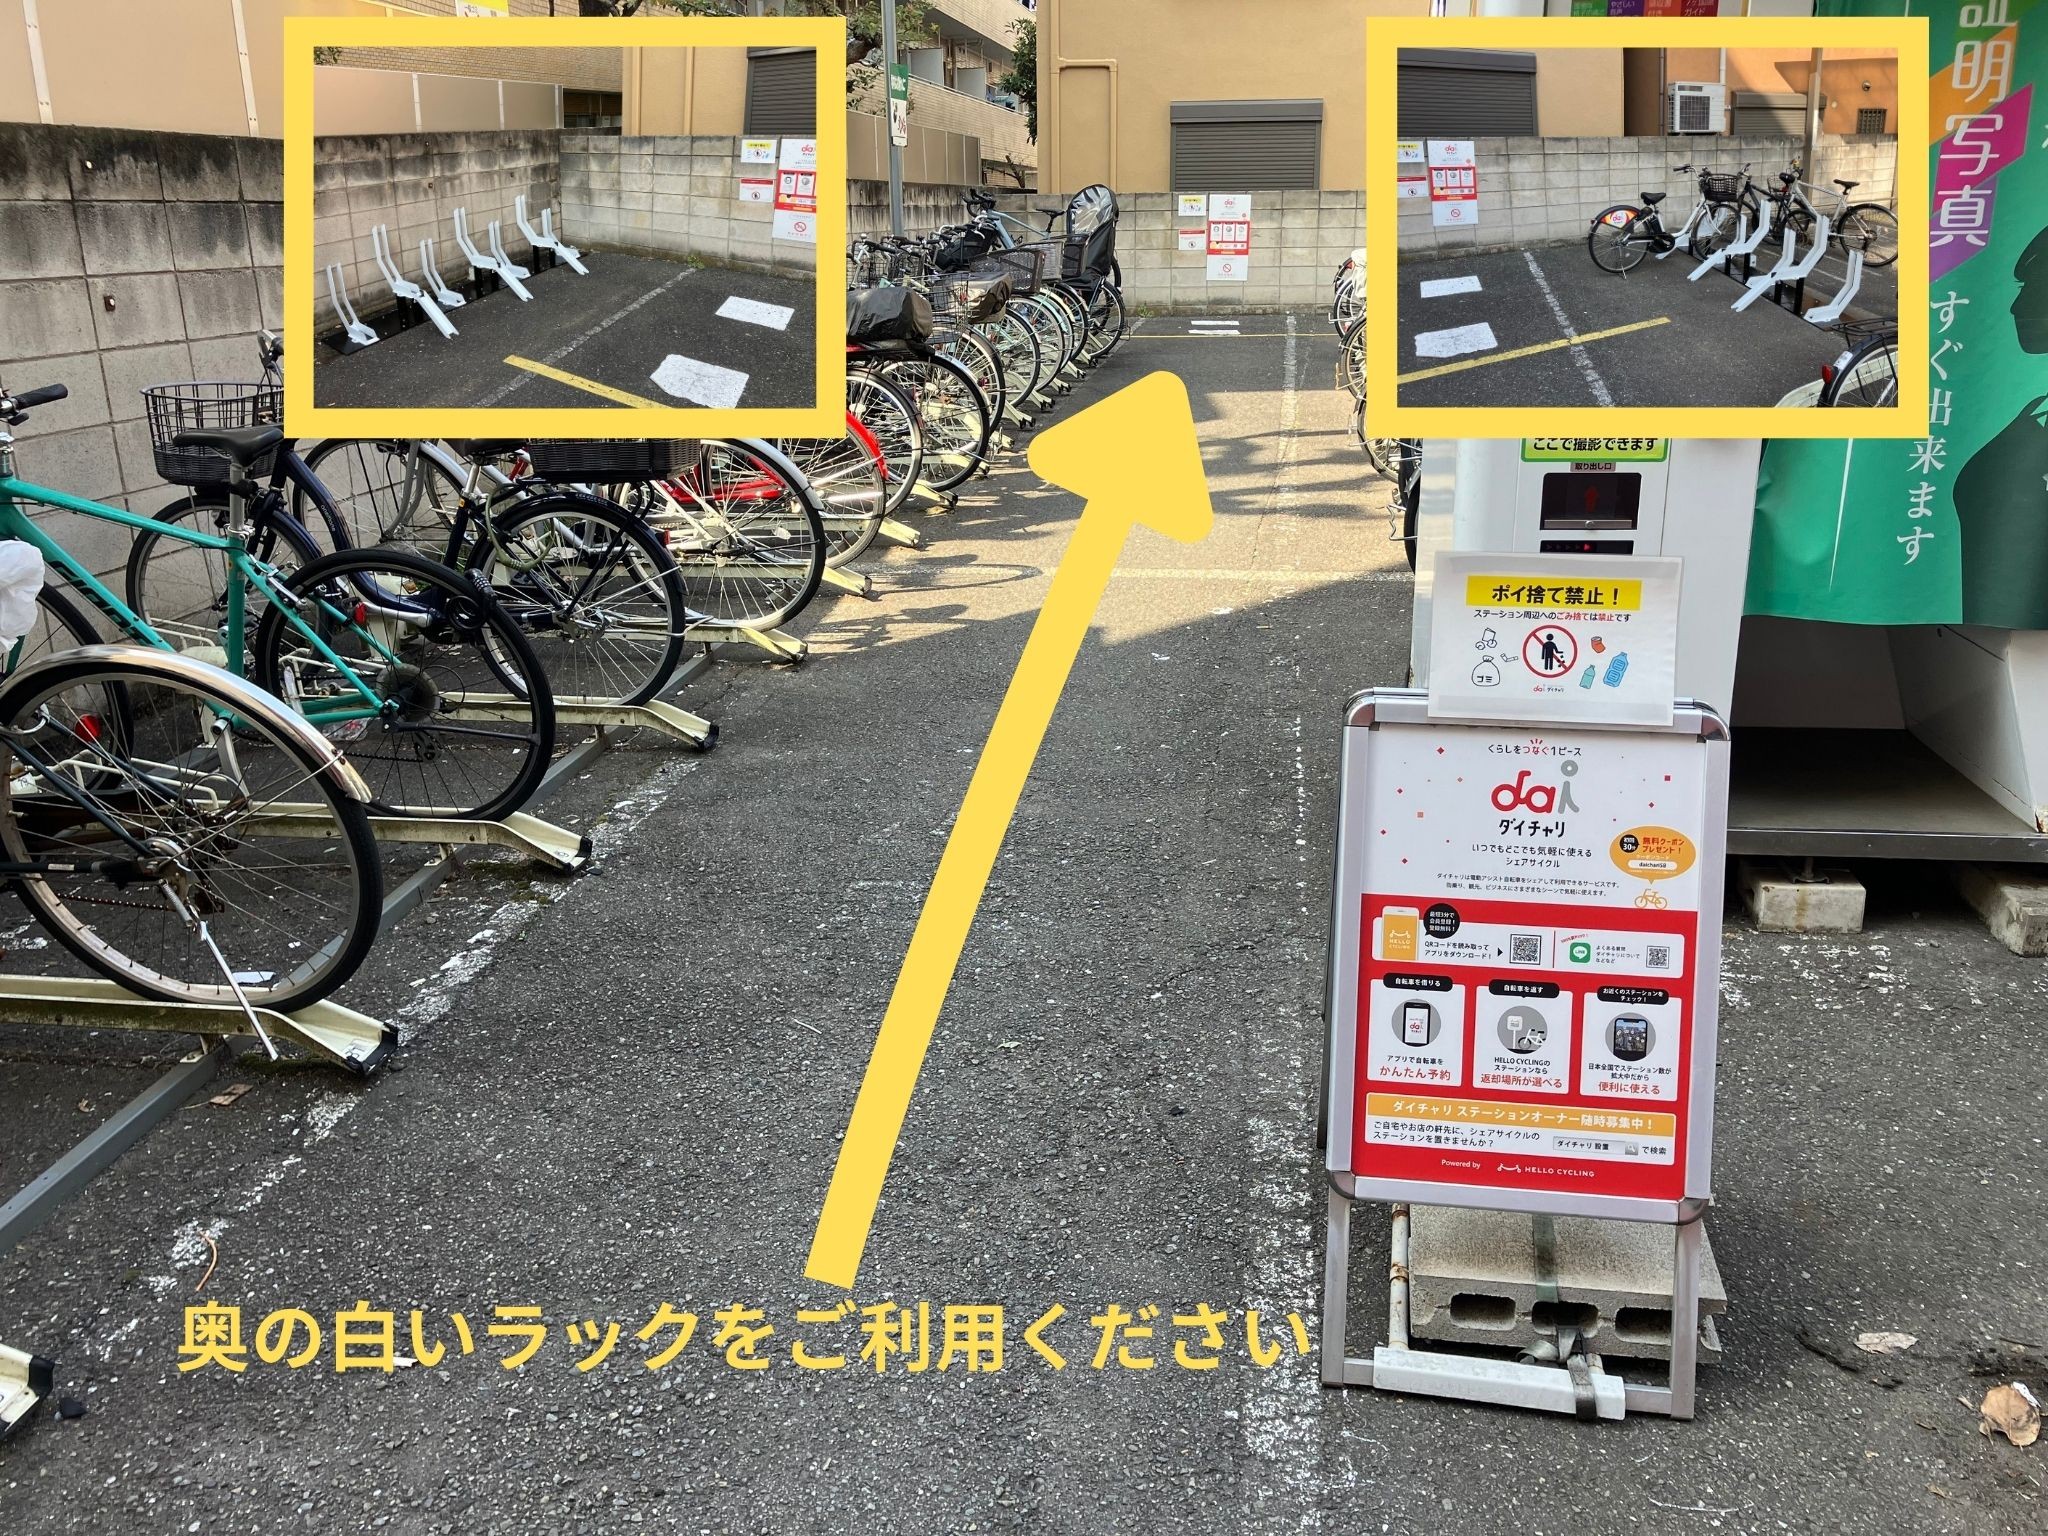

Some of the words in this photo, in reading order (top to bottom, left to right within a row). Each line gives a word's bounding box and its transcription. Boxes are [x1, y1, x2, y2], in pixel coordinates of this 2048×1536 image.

[1574, 463, 1612, 471] 取り出し口
[1492, 585, 1620, 606] ポイ捨て禁止！
[1474, 610, 1631, 622] ステーション周辺へのごみ捨ては禁止です
[1488, 745, 1582, 756] くらしをつなぐ1ピース
[1491, 759, 1579, 814] dai
[1499, 819, 1565, 837] ダイチャリ
[1643, 837, 1685, 845] 無料クーポン
[1472, 844, 1592, 858] いつでもどこでも気軽に使える
[1506, 857, 1560, 868] シェアサイクル
[1425, 941, 1489, 950] QRコードを読み取って
[1425, 950, 1491, 959] アプリをダウンロード！
[1596, 951, 1640, 959] ダイチャリについて
[1395, 977, 1441, 986] 自転車を借りる
[1504, 984, 1543, 993] 自転車を返す
[1603, 988, 1664, 998] お近くのステーションを
[1387, 1055, 1444, 1065] アプリで自転車を
[1516, 1058, 1550, 1066] CYCLINGの
[1379, 1065, 1451, 1081] かんたん予約
[1494, 1064, 1548, 1075] ステーションなら
[1588, 1063, 1671, 1075] 日本全国でステーション数が
[1481, 1073, 1562, 1088] 返却場所が選べる
[1610, 1073, 1650, 1081] 拡大中だから
[1598, 1081, 1660, 1095] 便利に使える
[1392, 1100, 1453, 1116] ダイチャリ
[1457, 1105, 1655, 1132] ステーションオーナー随時募集中！
[1373, 1120, 1540, 1141] ご自宅やお店の軒先に、シェアサイクルの
[1373, 1132, 1495, 1148] ステーションを置きませんか？
[1556, 1140, 1593, 1150] ダイチャリ
[1594, 1142, 1610, 1152] 設置
[1642, 1146, 1667, 1155] で検索
[1441, 1159, 1469, 1169] Powered
[1471, 1161, 1481, 1171] by
[1524, 1166, 1554, 1175] HELLO
[1556, 1168, 1595, 1177] CYCLING
